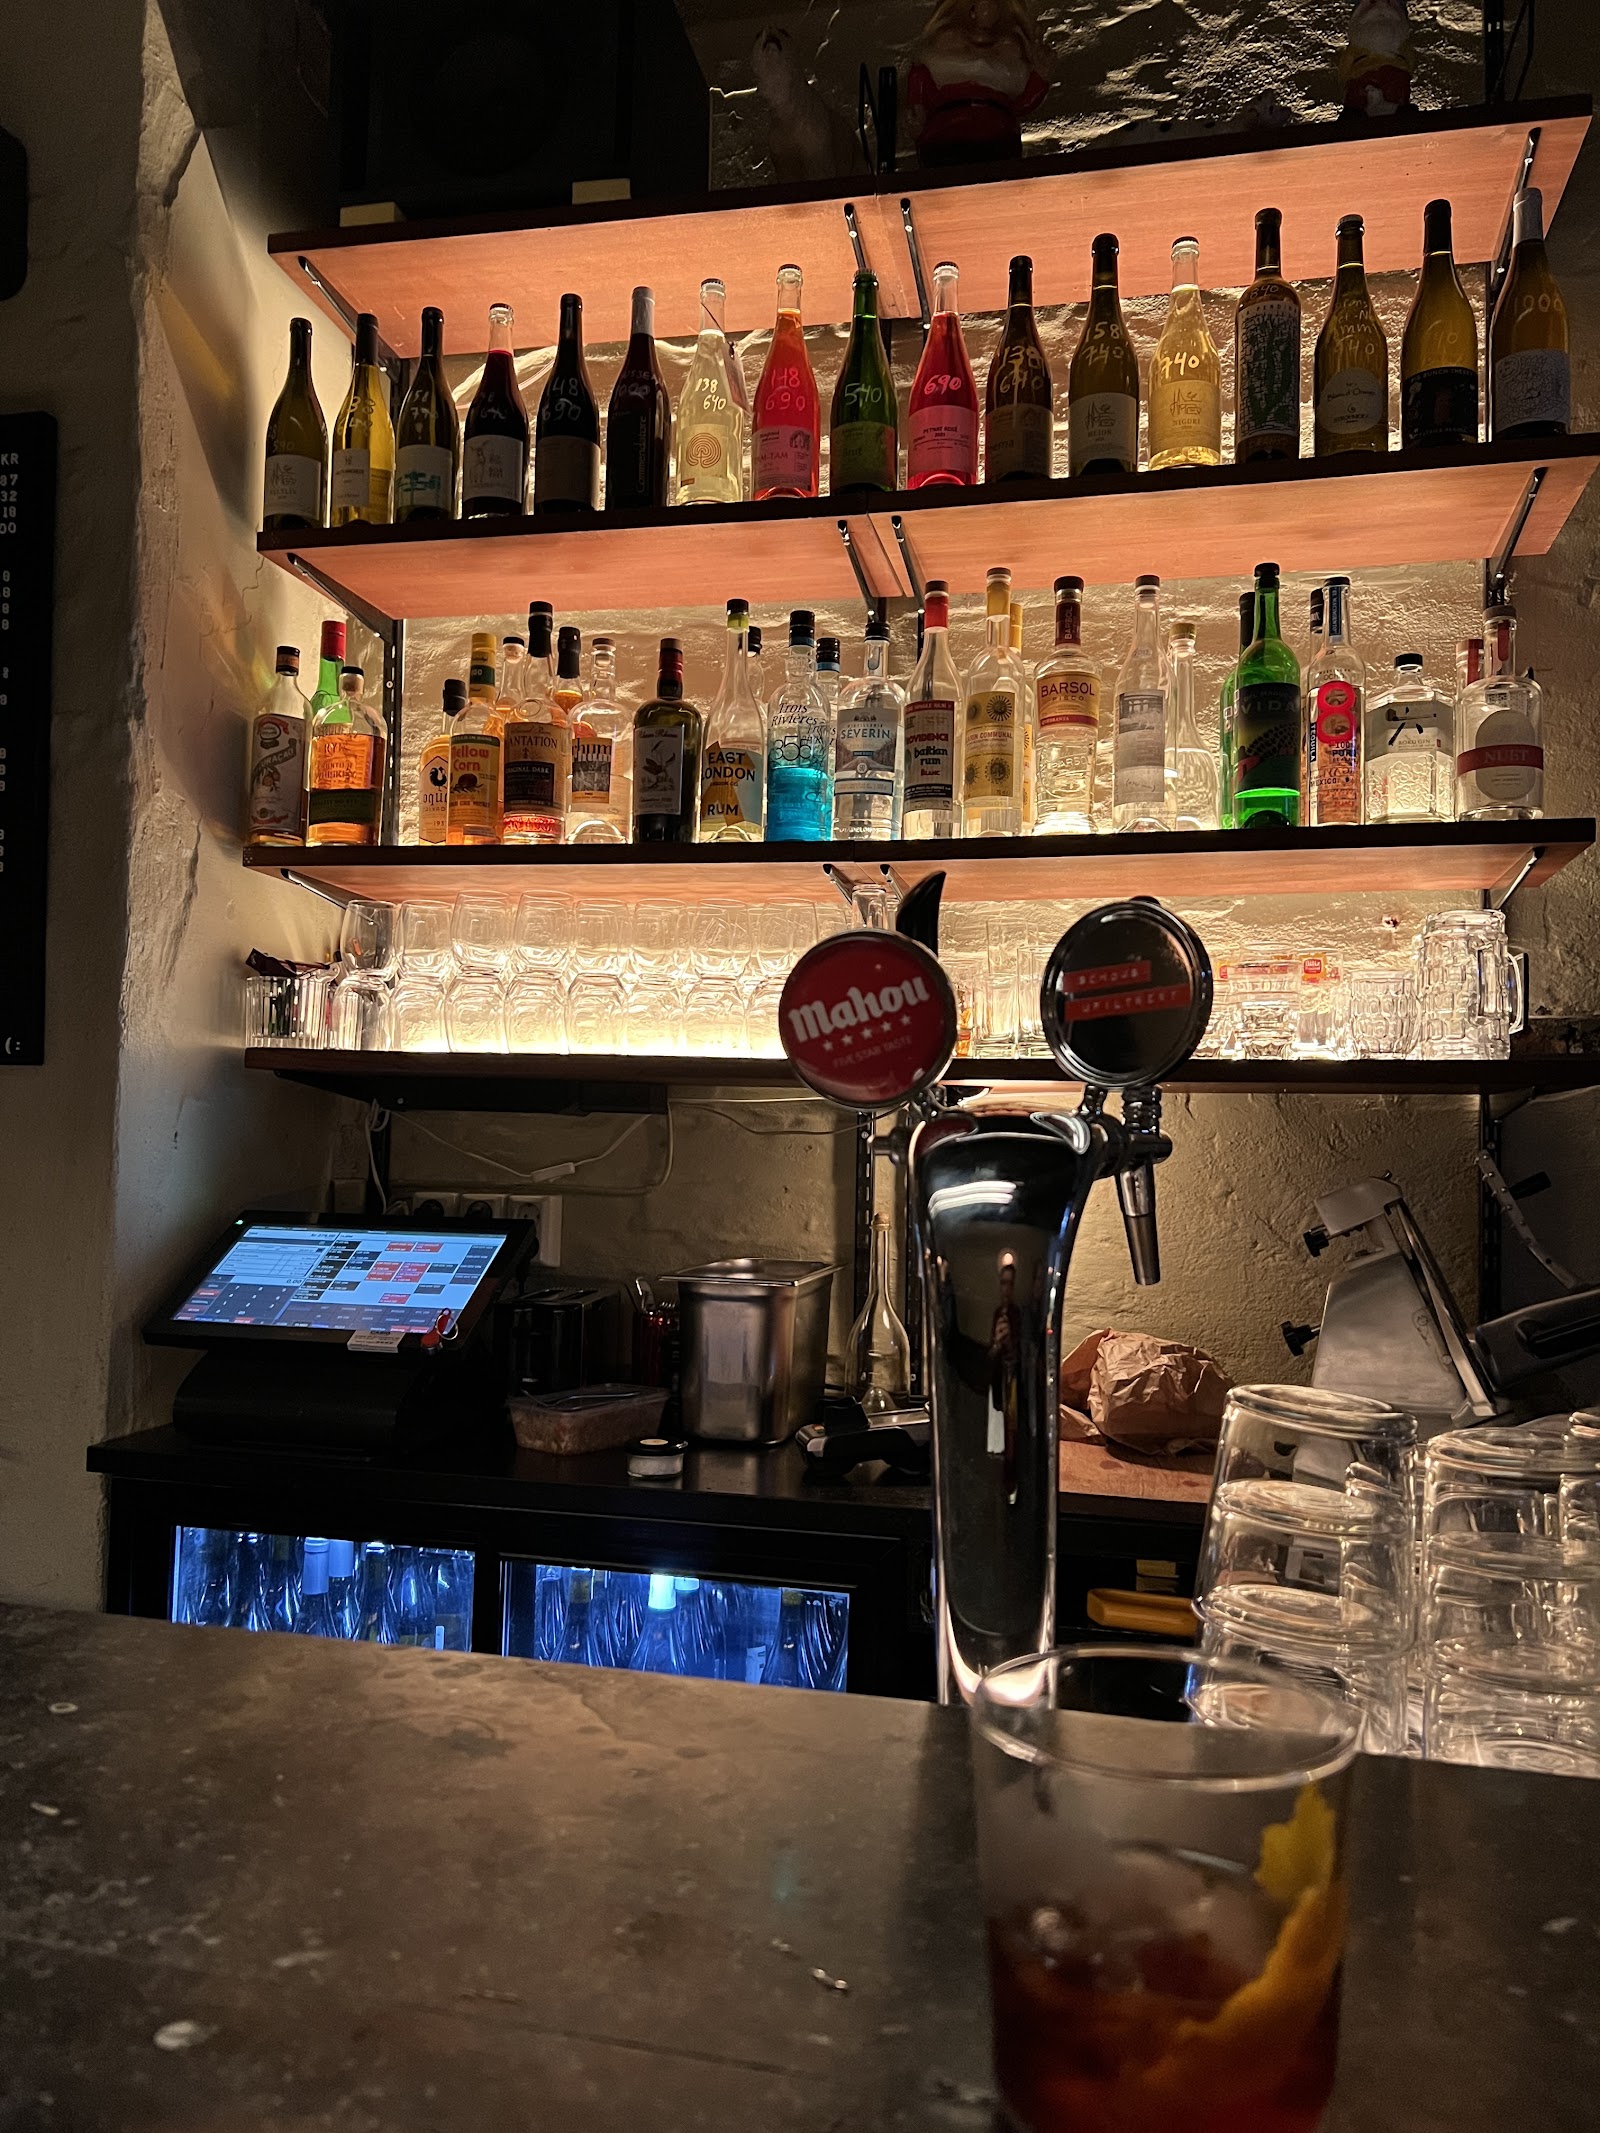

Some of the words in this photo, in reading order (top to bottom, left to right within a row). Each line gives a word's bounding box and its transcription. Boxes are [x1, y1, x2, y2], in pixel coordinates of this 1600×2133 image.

[1159, 352, 1200, 379] 740
[695, 378, 718, 393] 138
[924, 374, 962, 395] 690
[765, 388, 806, 411] 690
[844, 382, 882, 407] 540
[703, 394, 727, 412] 640
[1040, 681, 1095, 698] BARSOL
[778, 702, 808, 714] Trois
[1240, 699, 1297, 714] VIDA
[771, 713, 817, 727] Rivières
[840, 727, 891, 740] SÉVERIN
[509, 735, 558, 749] ANTATION
[453, 759, 480, 772] Corn
[708, 751, 746, 765] EAST
[920, 757, 941, 766] rum
[707, 803, 739, 816] RUM
[787, 975, 931, 1043] Mahou
